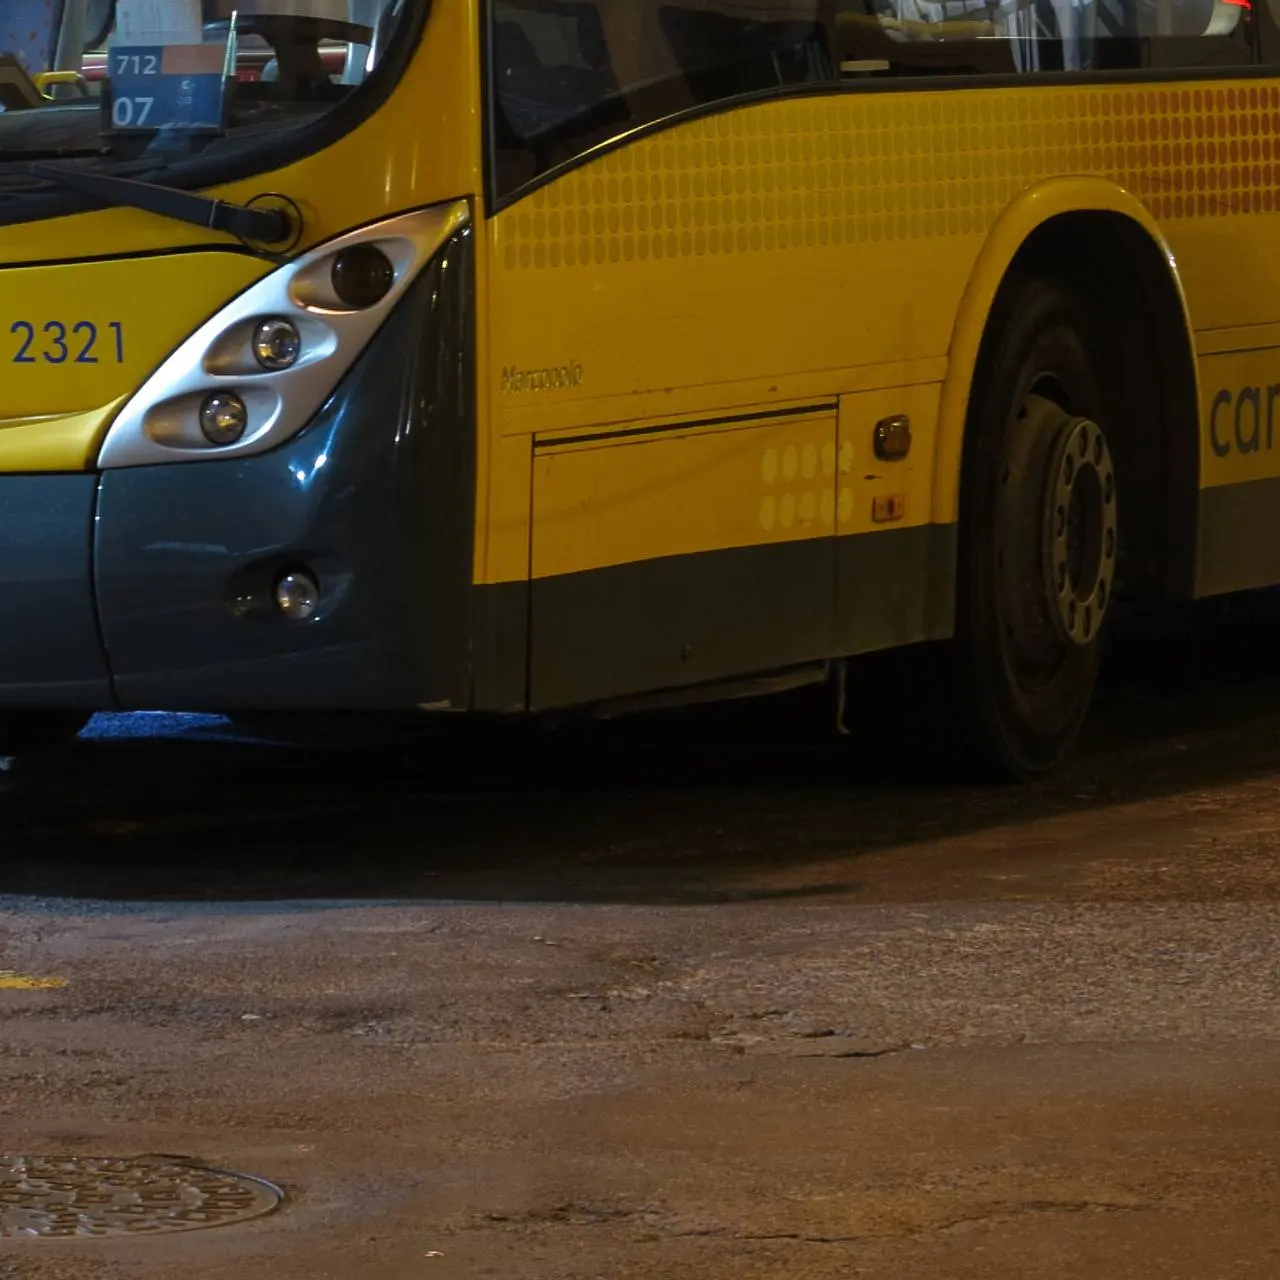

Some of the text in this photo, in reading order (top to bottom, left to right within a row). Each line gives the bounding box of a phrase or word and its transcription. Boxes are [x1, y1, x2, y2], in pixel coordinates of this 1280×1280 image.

[116, 55, 157, 75] 712
[113, 96, 155, 127] 07
[9, 320, 125, 364] 2321
